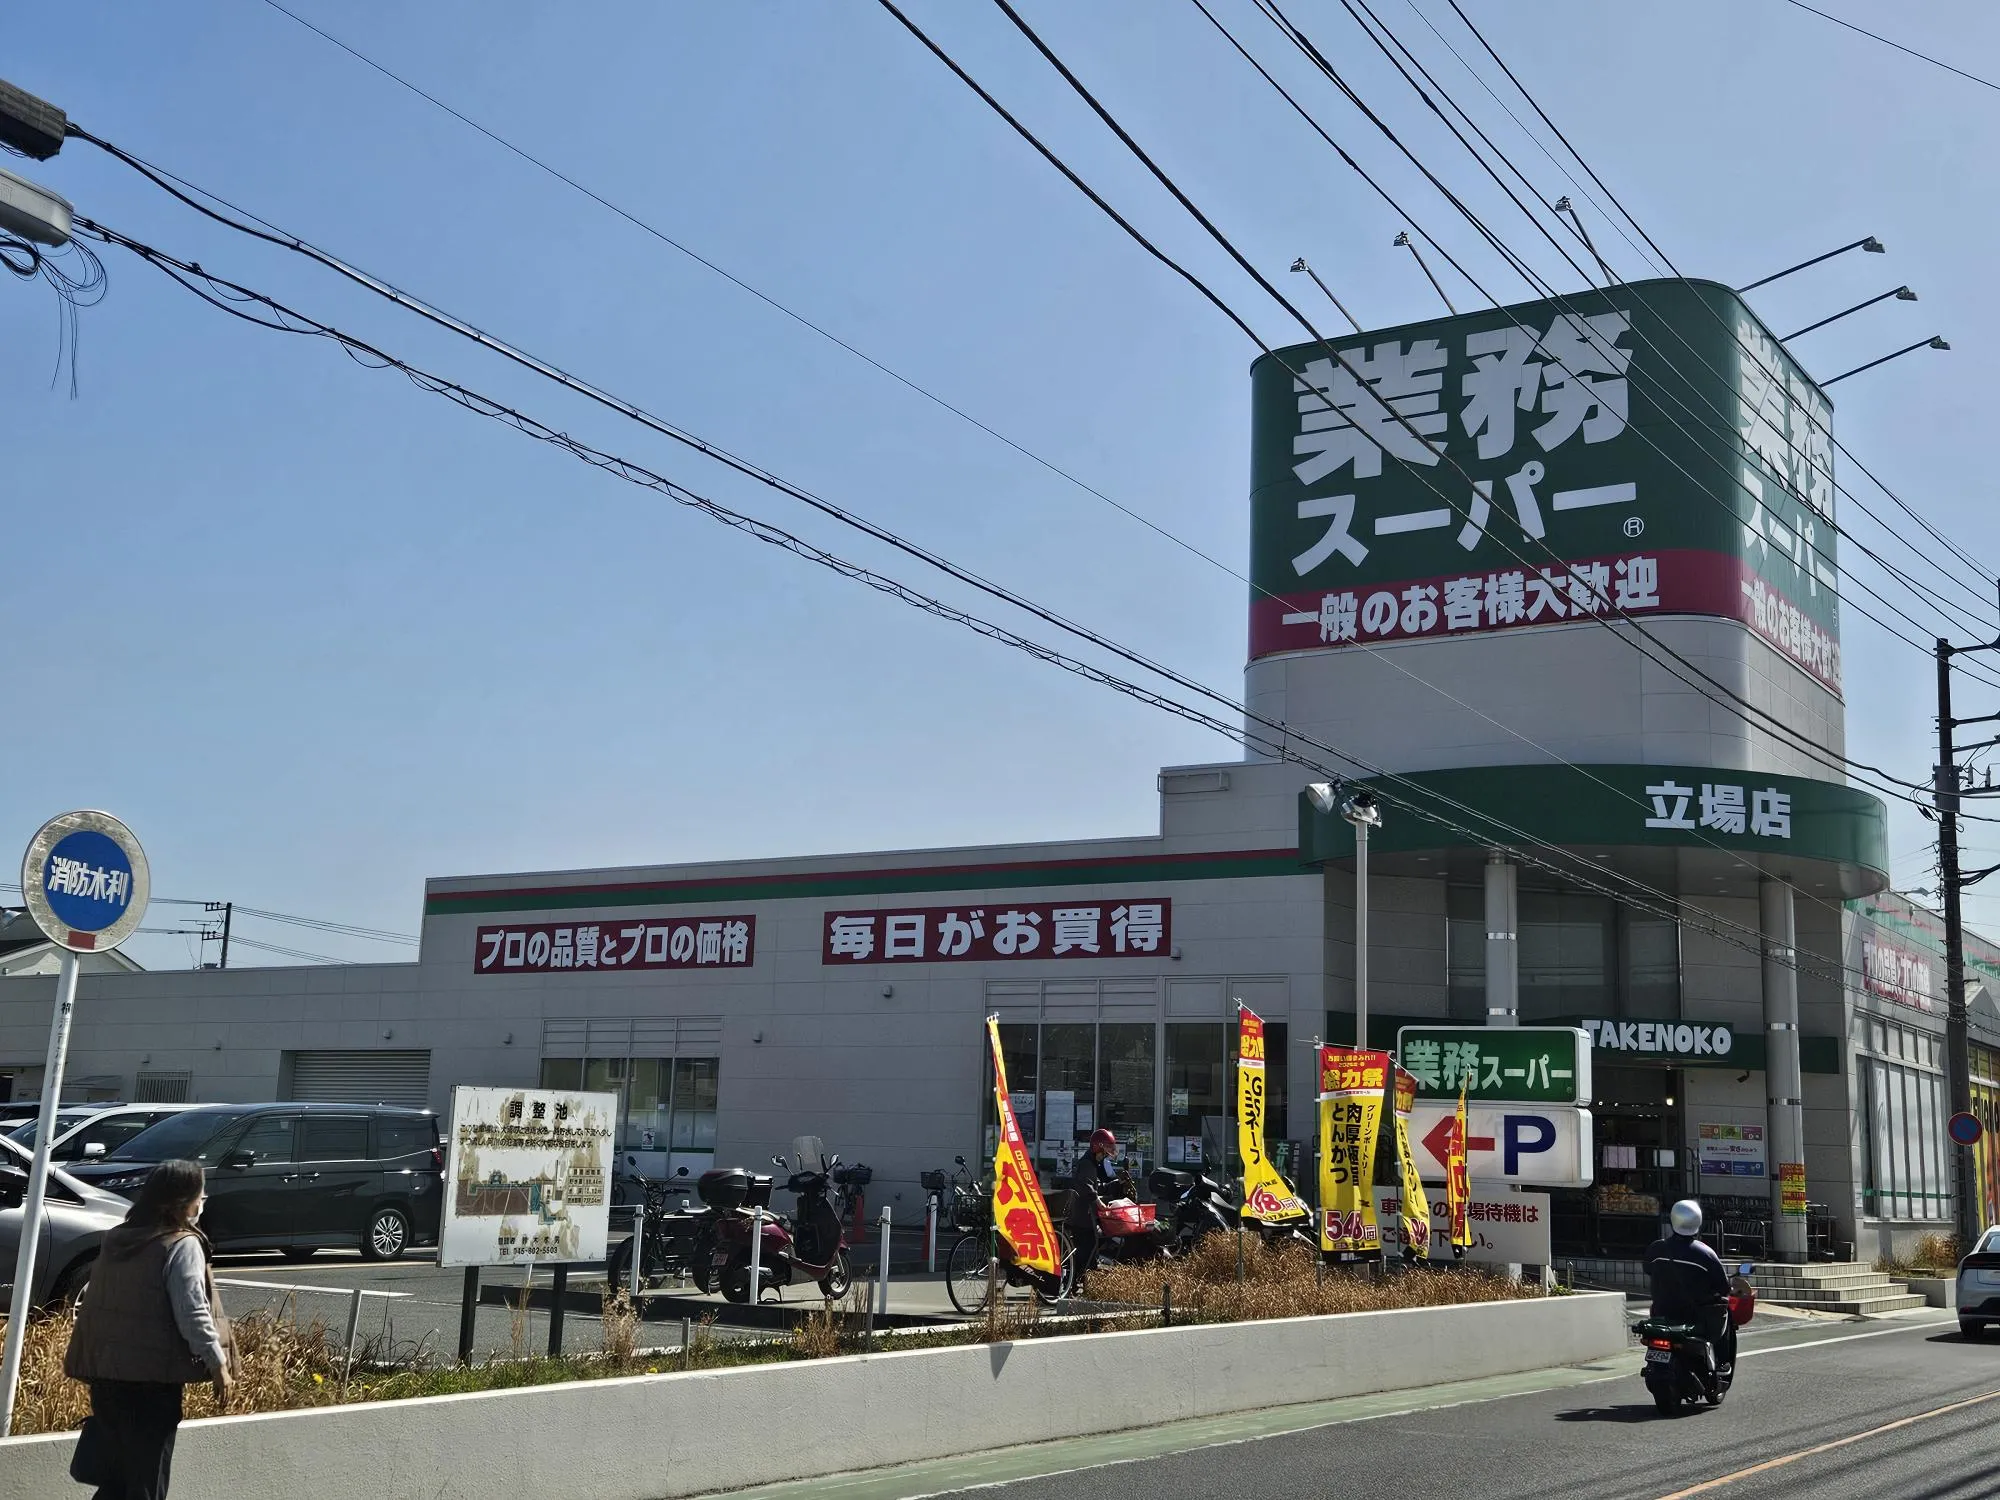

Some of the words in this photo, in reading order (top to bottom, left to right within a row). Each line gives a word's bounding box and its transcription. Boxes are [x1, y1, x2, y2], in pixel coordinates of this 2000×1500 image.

[1292, 309, 1634, 487] 業務
[1737, 320, 1835, 527] 業務
[1292, 460, 1637, 577] スーパー
[1743, 467, 1837, 597] スーパー
[1281, 556, 1660, 644] 一般のお客様大歓迎
[1646, 781, 1791, 838] 立場店
[48, 856, 129, 906] 消防水利
[481, 920, 748, 968] プロの品質とプロの価格
[830, 904, 1164, 960] 毎日がお買得
[1405, 1040, 1572, 1091] 業務スーパー
[1582, 1019, 1732, 1055] TAKENOKO
[509, 1101, 568, 1120] 調整池
[1329, 1102, 1349, 1184] とんかつ
[1504, 1115, 1556, 1175] P
